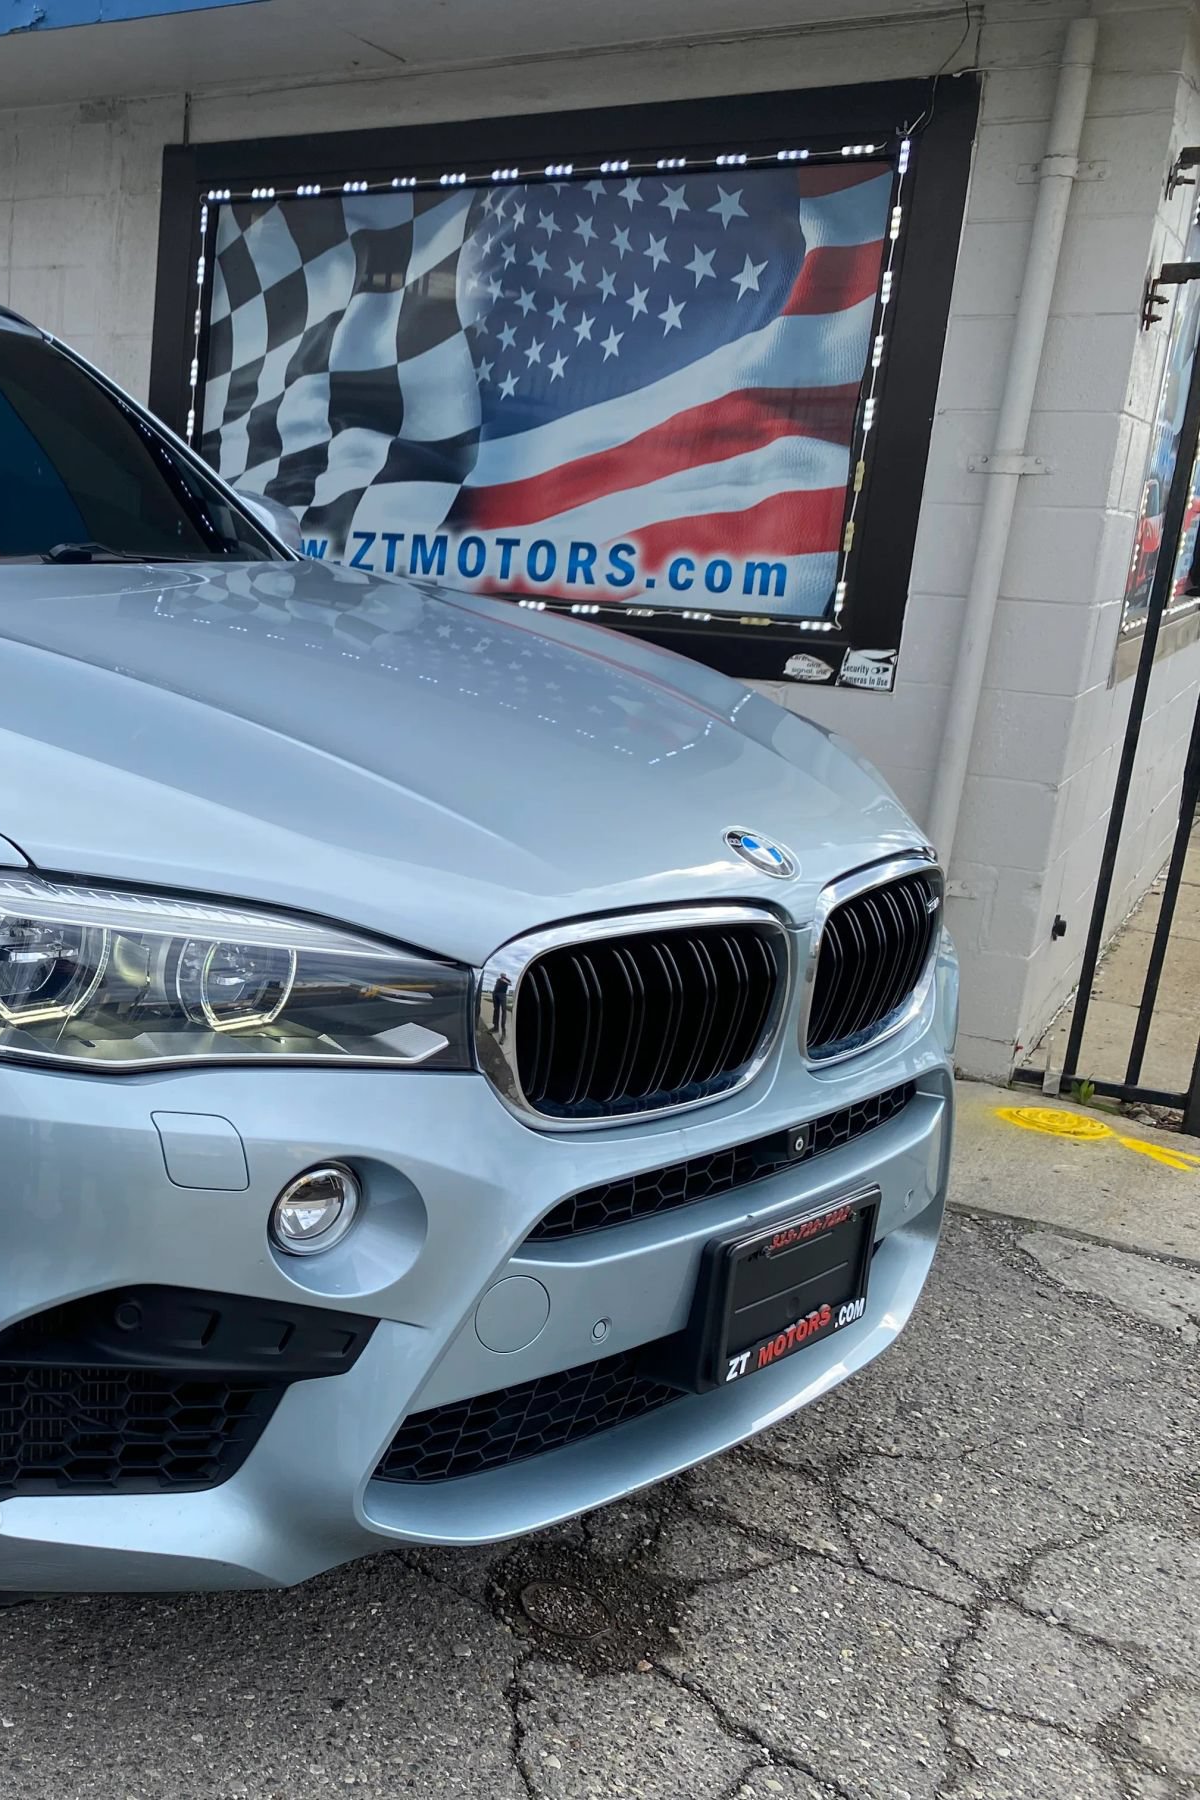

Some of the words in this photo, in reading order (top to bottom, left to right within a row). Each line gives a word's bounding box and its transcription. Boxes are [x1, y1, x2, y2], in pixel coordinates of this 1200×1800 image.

[843, 663, 870, 676] Security
[725, 1351, 751, 1382] ZT
[757, 1303, 832, 1369] MOTORS
[834, 1297, 866, 1328] .COM
